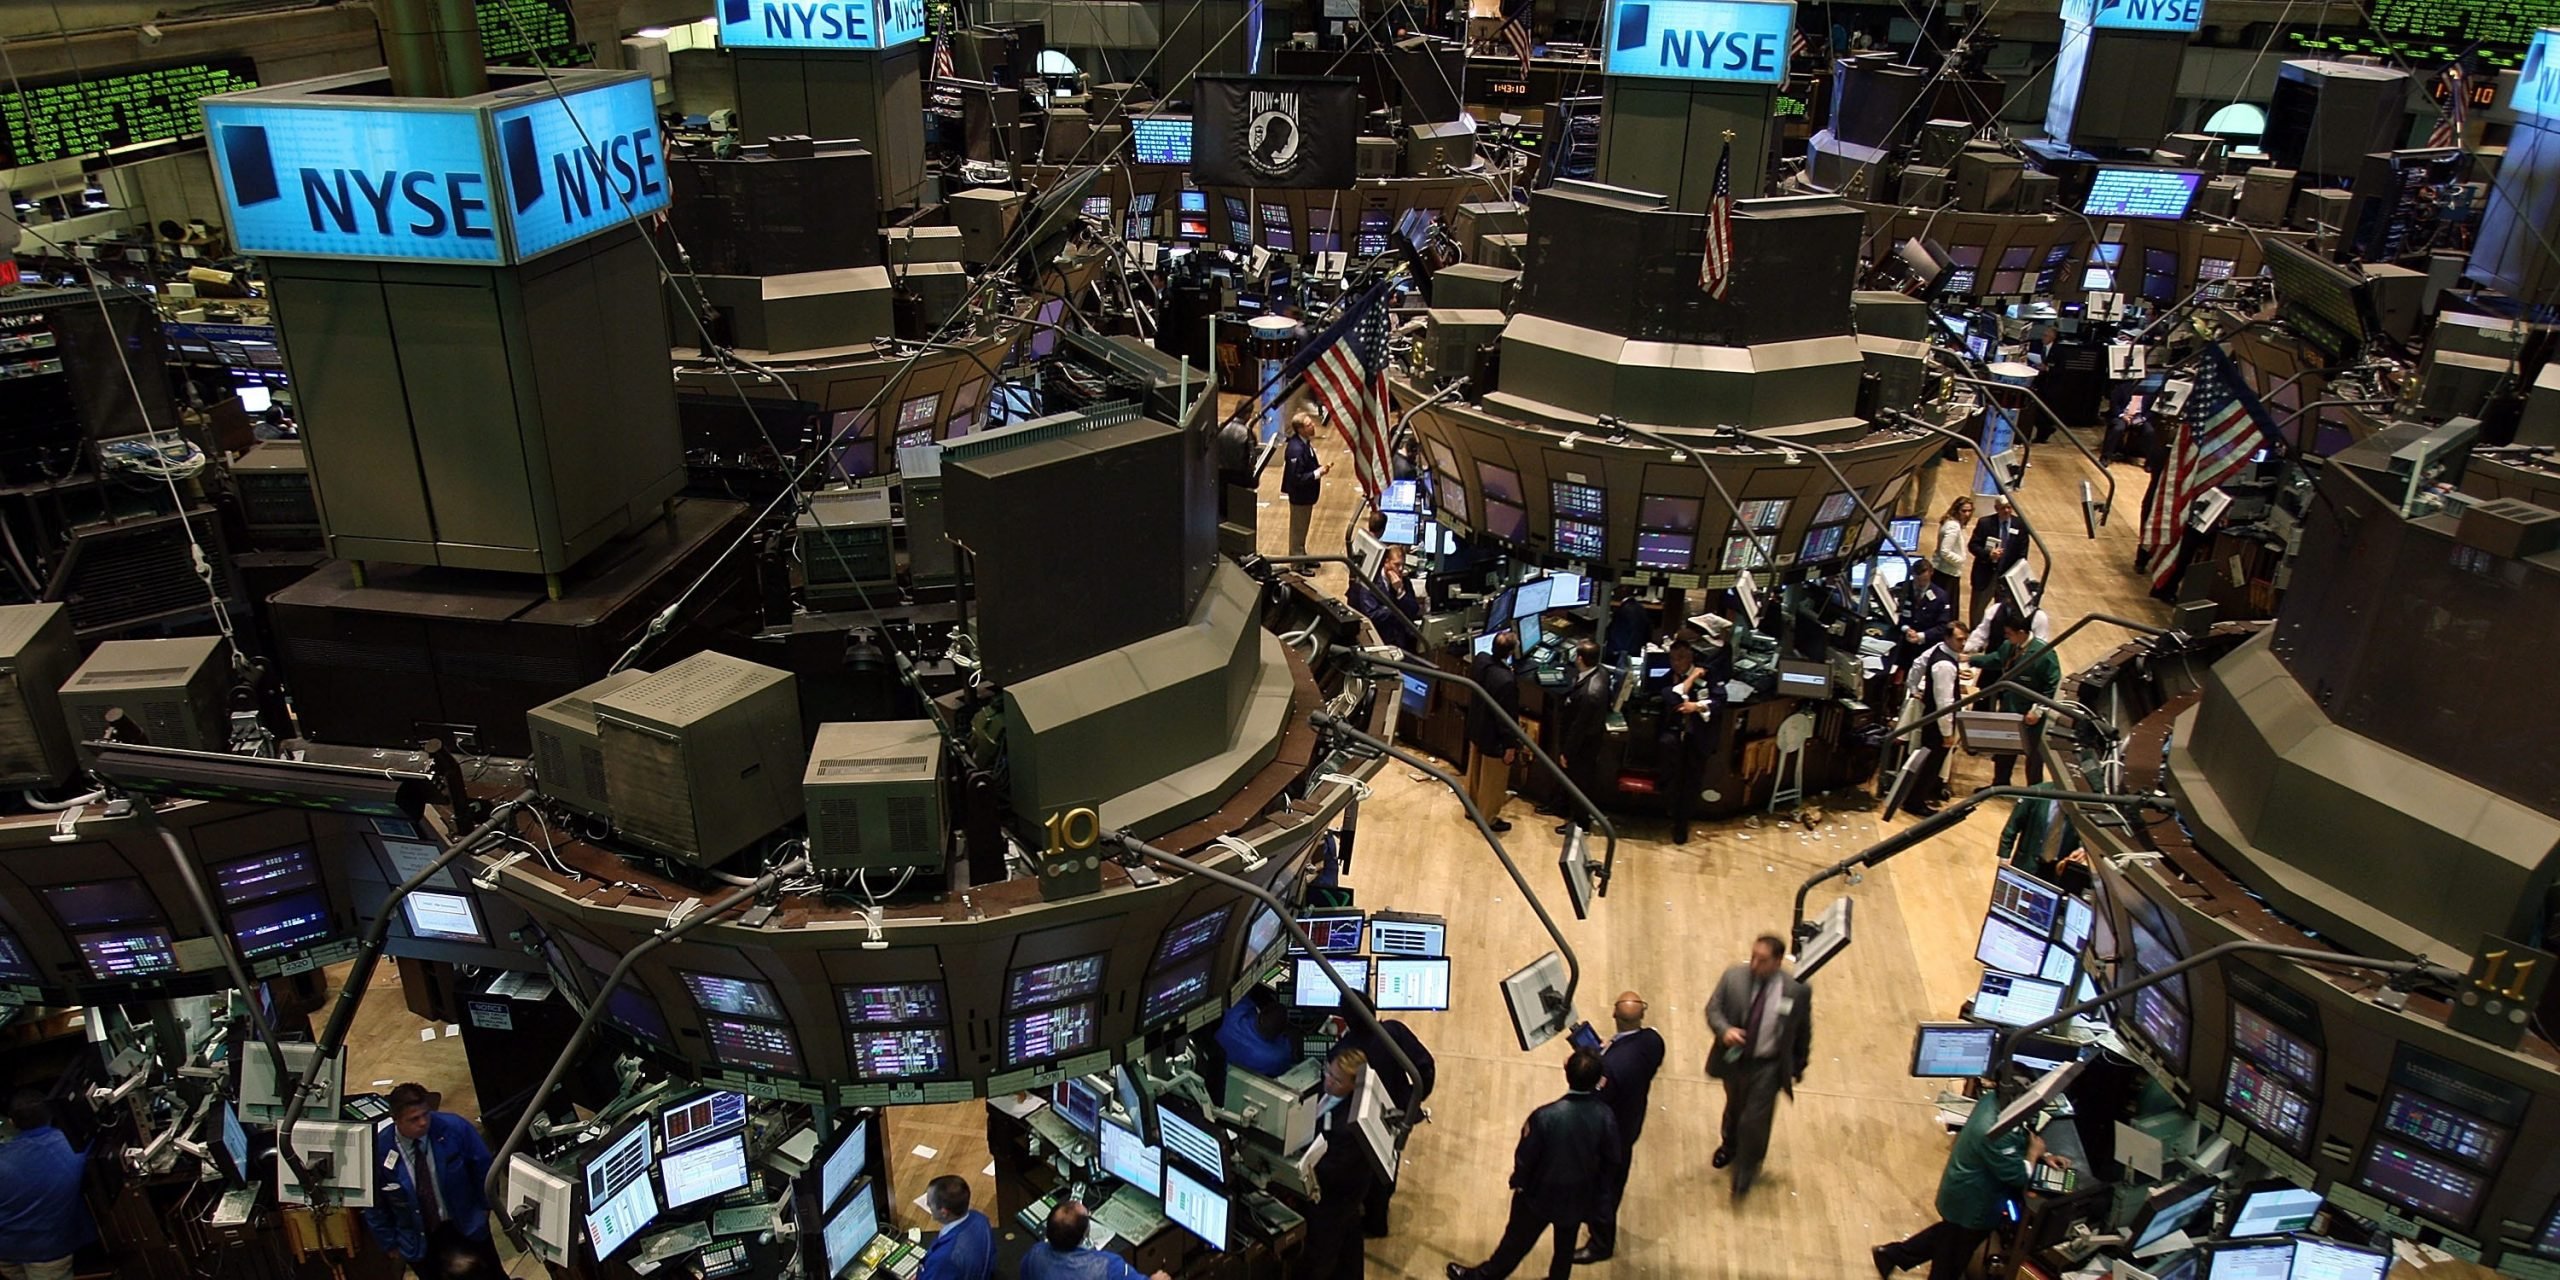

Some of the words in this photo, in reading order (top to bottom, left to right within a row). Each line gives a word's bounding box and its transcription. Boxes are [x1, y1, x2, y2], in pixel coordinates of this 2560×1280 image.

[764, 2, 868, 40] NYSE
[894, 0, 924, 33] NYSE
[2126, 0, 2198, 22] NYSE
[1660, 28, 1777, 72] NYSE
[1494, 84, 1526, 93] 1:43:10
[1249, 90, 1274, 124] POW
[1280, 92, 1299, 127] MIA
[553, 128, 661, 224] NYSE
[300, 167, 493, 239] NYSE
[1044, 807, 1099, 856] 10
[285, 959, 309, 971] 2320
[2473, 949, 2537, 1002] 11
